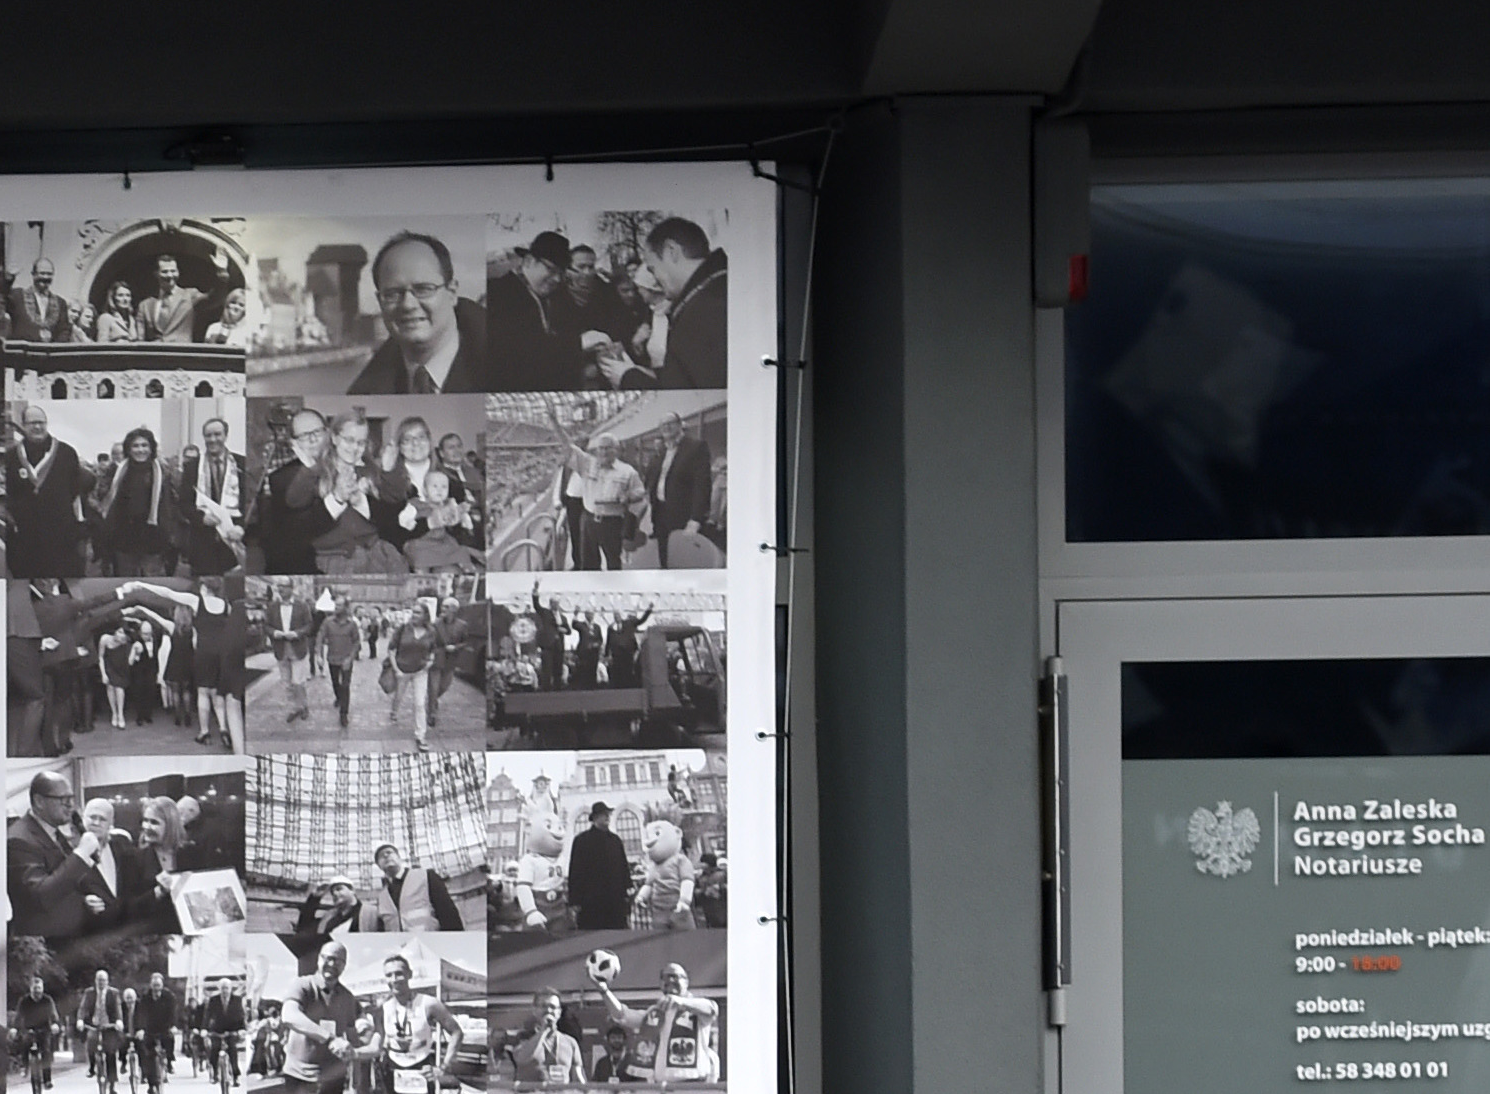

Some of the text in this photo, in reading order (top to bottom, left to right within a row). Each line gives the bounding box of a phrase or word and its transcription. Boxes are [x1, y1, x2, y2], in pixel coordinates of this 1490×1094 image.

[1294, 798, 1458, 822] Anna Zaleska
[1293, 823, 1486, 851] Grzegorz Socha
[1294, 854, 1423, 876] Notariusze
[1295, 927, 1415, 950] poniedziałek
[1295, 955, 1336, 973] 9:00
[1295, 996, 1366, 1014] sobota:
[1296, 1024, 1321, 1043] po
[1324, 1020, 1459, 1042] wcześniejszym
[1296, 1060, 1448, 1081] tel.: 58 348 01 01
